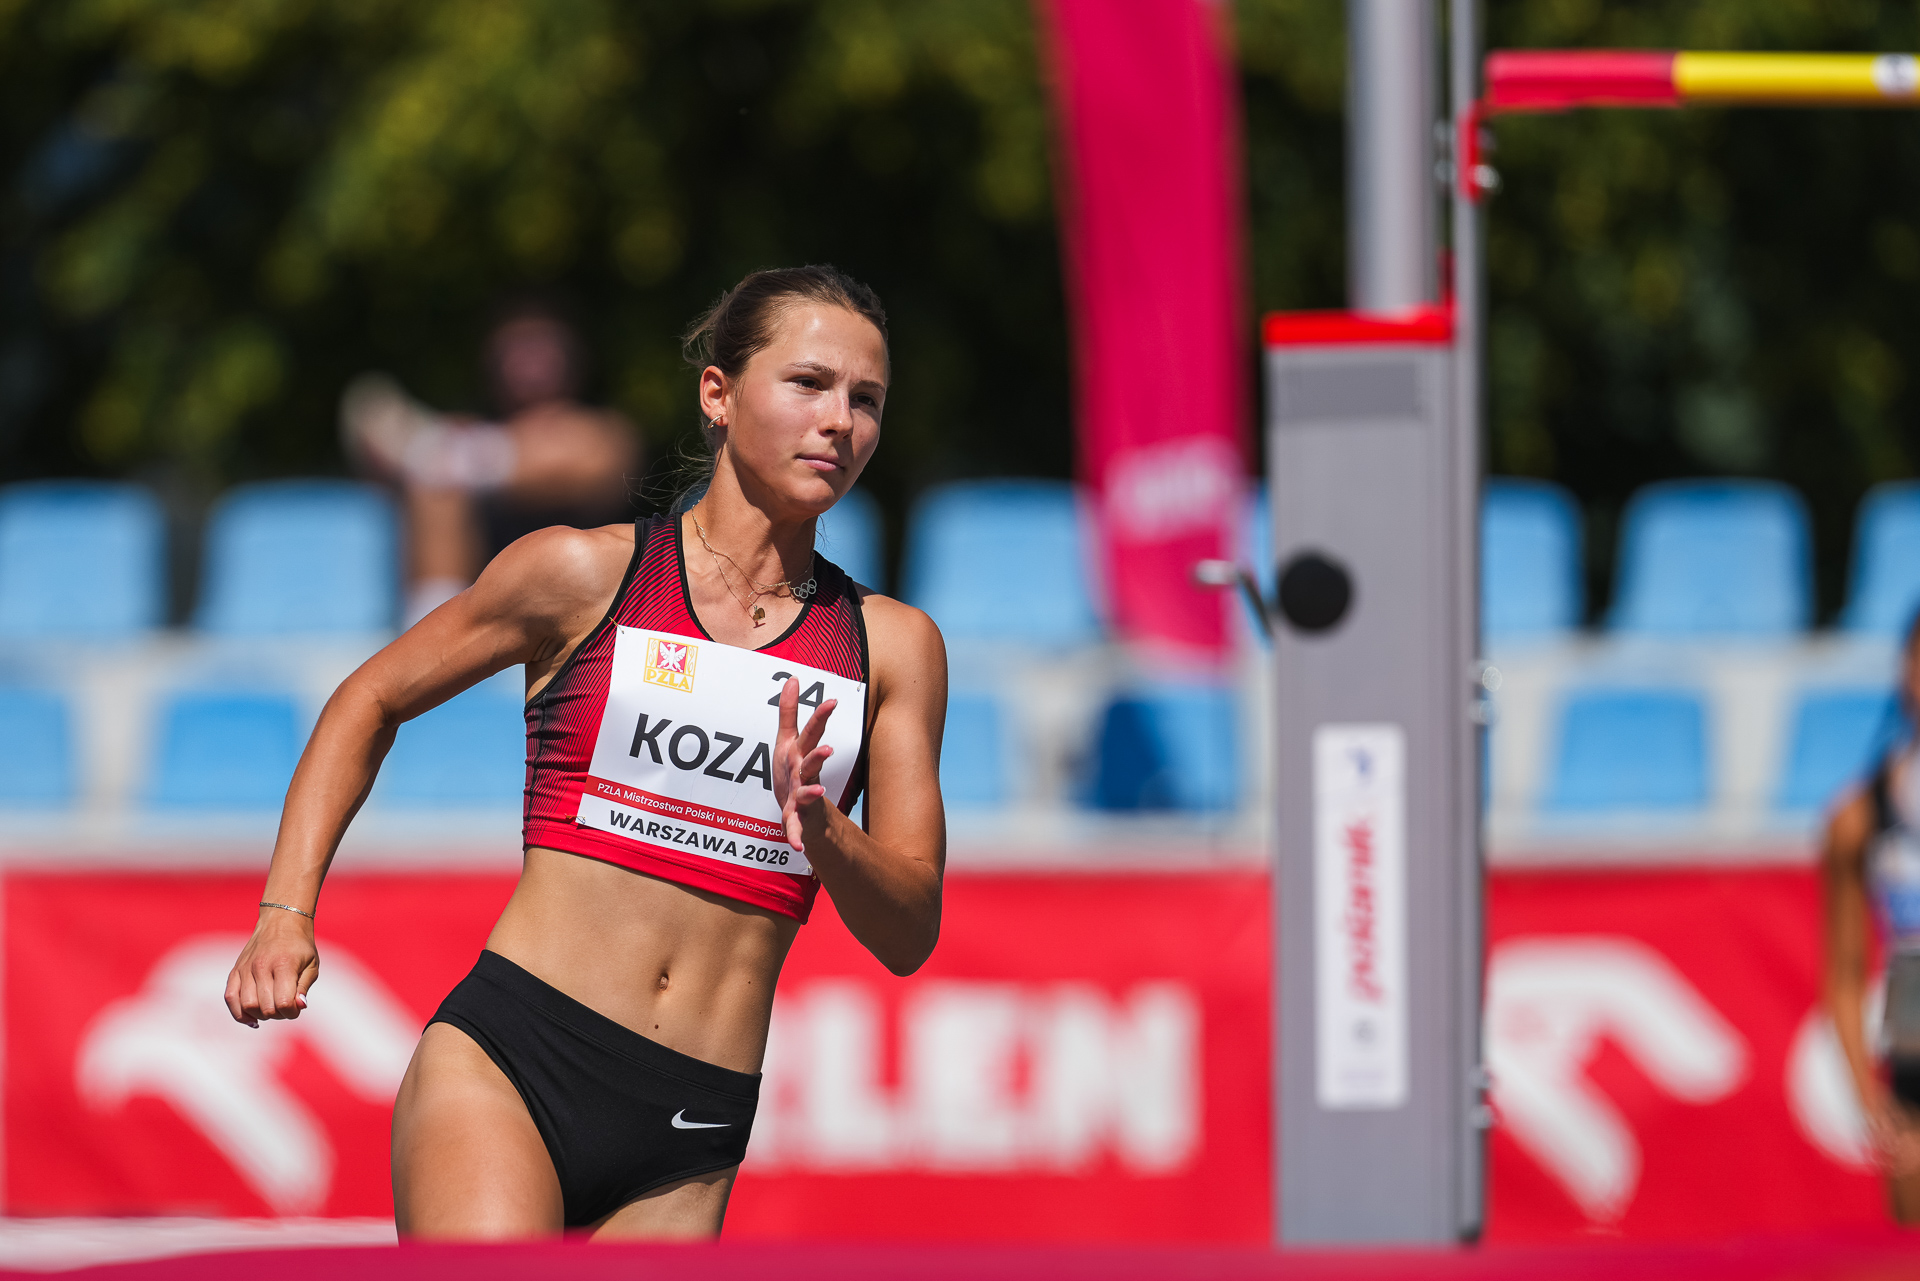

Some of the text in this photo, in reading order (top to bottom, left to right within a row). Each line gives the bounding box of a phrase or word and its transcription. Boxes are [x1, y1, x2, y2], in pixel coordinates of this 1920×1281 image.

[646, 668, 690, 690] PZLA
[629, 712, 773, 792] KOZA
[597, 782, 621, 798] PZLA
[623, 790, 684, 814] Mistrzostwa
[684, 806, 715, 822] Polski
[716, 815, 726, 824] w
[610, 809, 790, 866] WARSZAWA 2026
